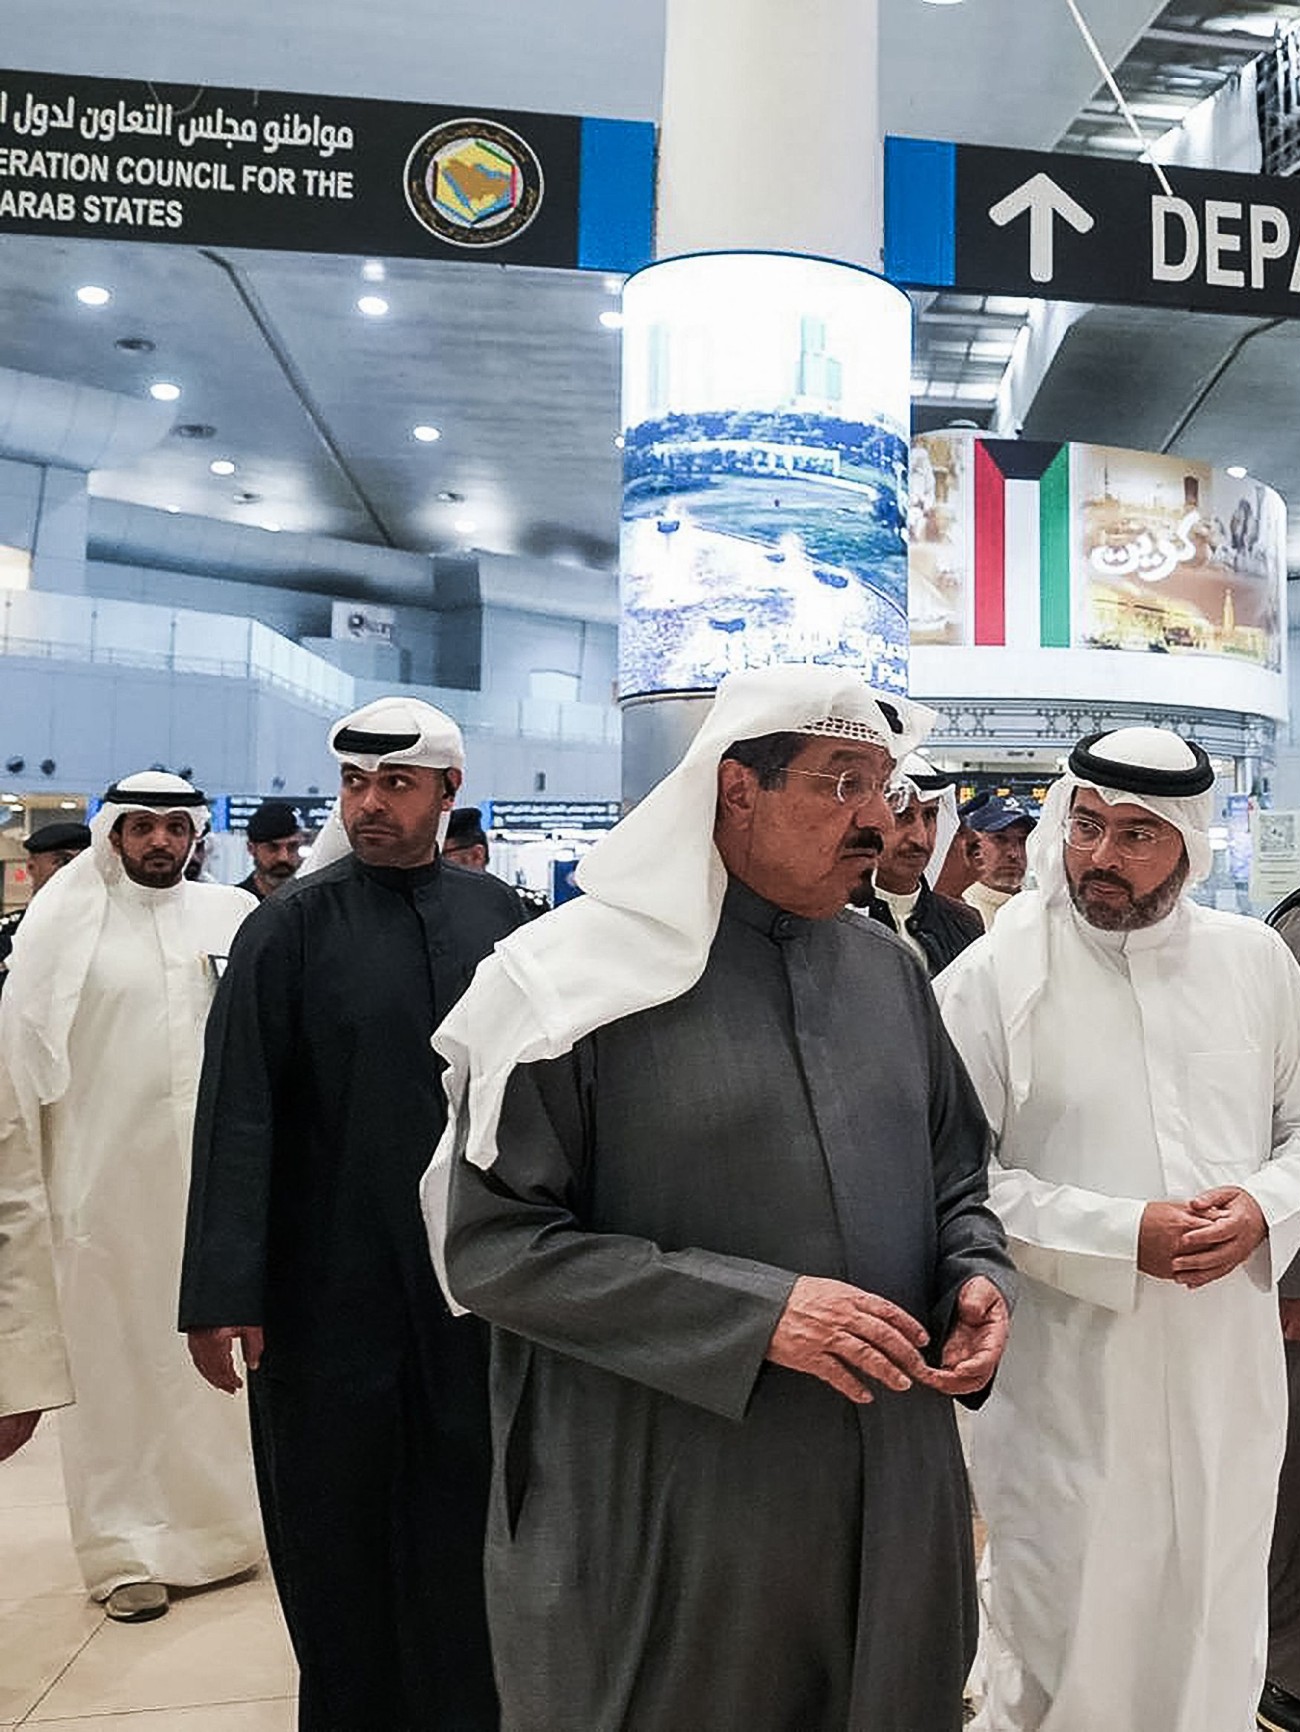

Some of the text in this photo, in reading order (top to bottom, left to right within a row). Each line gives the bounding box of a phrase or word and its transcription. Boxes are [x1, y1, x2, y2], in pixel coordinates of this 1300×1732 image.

[13, 93, 75, 136] لدول
[80, 100, 173, 141] التعاون
[178, 107, 257, 149] مجلس
[263, 113, 354, 157] مواطنو
[116, 156, 235, 192] COUNCIL
[242, 164, 297, 196] FOR
[302, 168, 354, 199] THE
[0, 189, 183, 229] ARAB STATES
